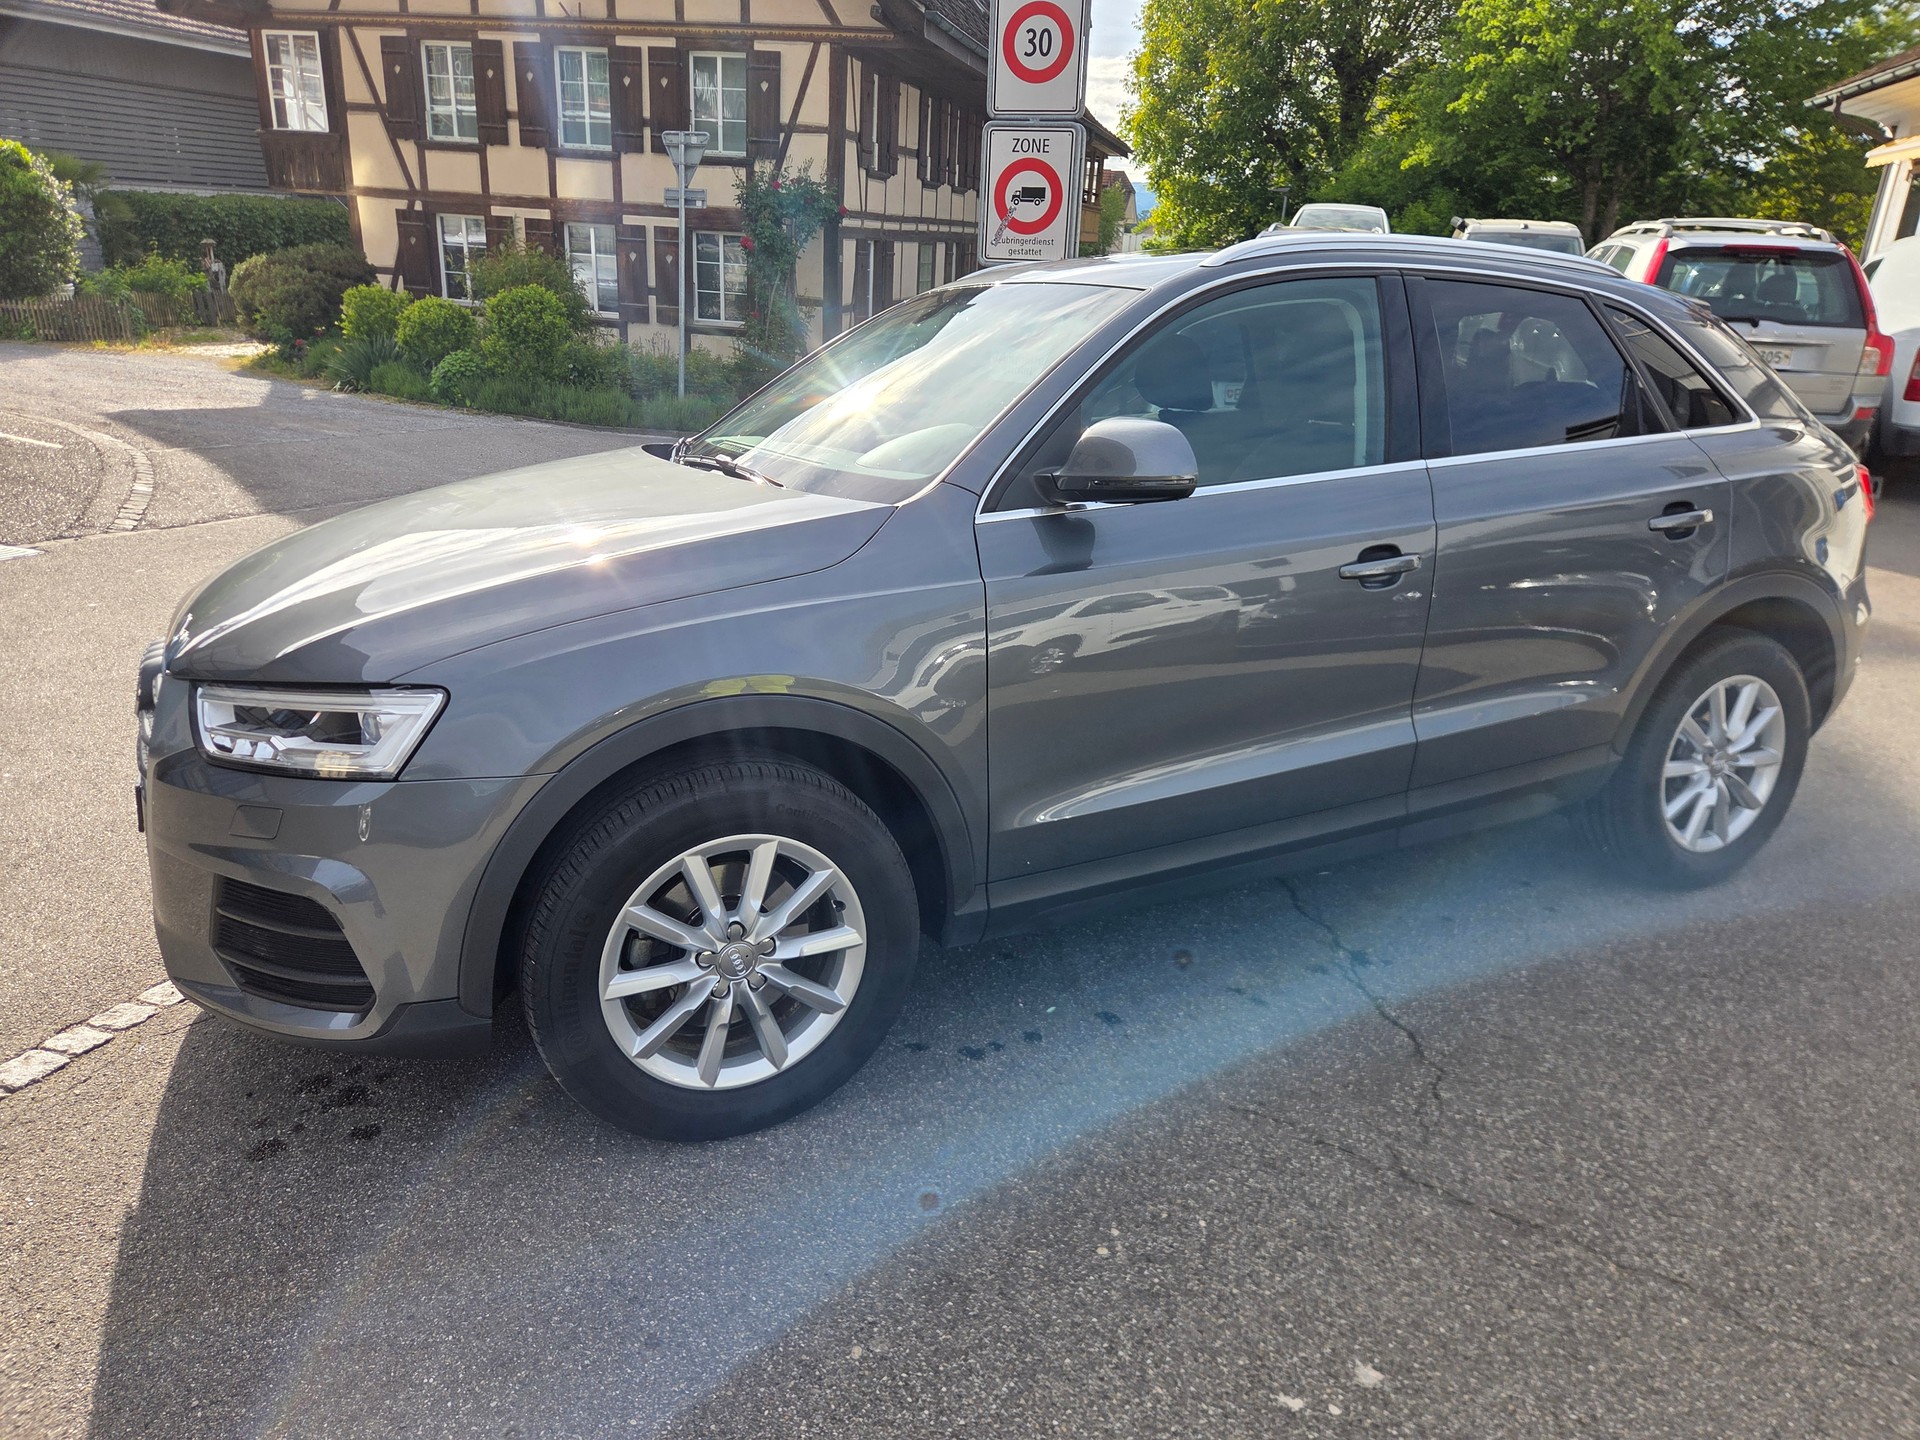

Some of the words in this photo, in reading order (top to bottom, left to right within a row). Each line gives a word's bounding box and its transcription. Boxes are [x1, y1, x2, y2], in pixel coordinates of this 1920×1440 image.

[1024, 27, 1052, 57] 30
[1012, 138, 1050, 154] ZONE
[1008, 248, 1042, 256] gestattet
